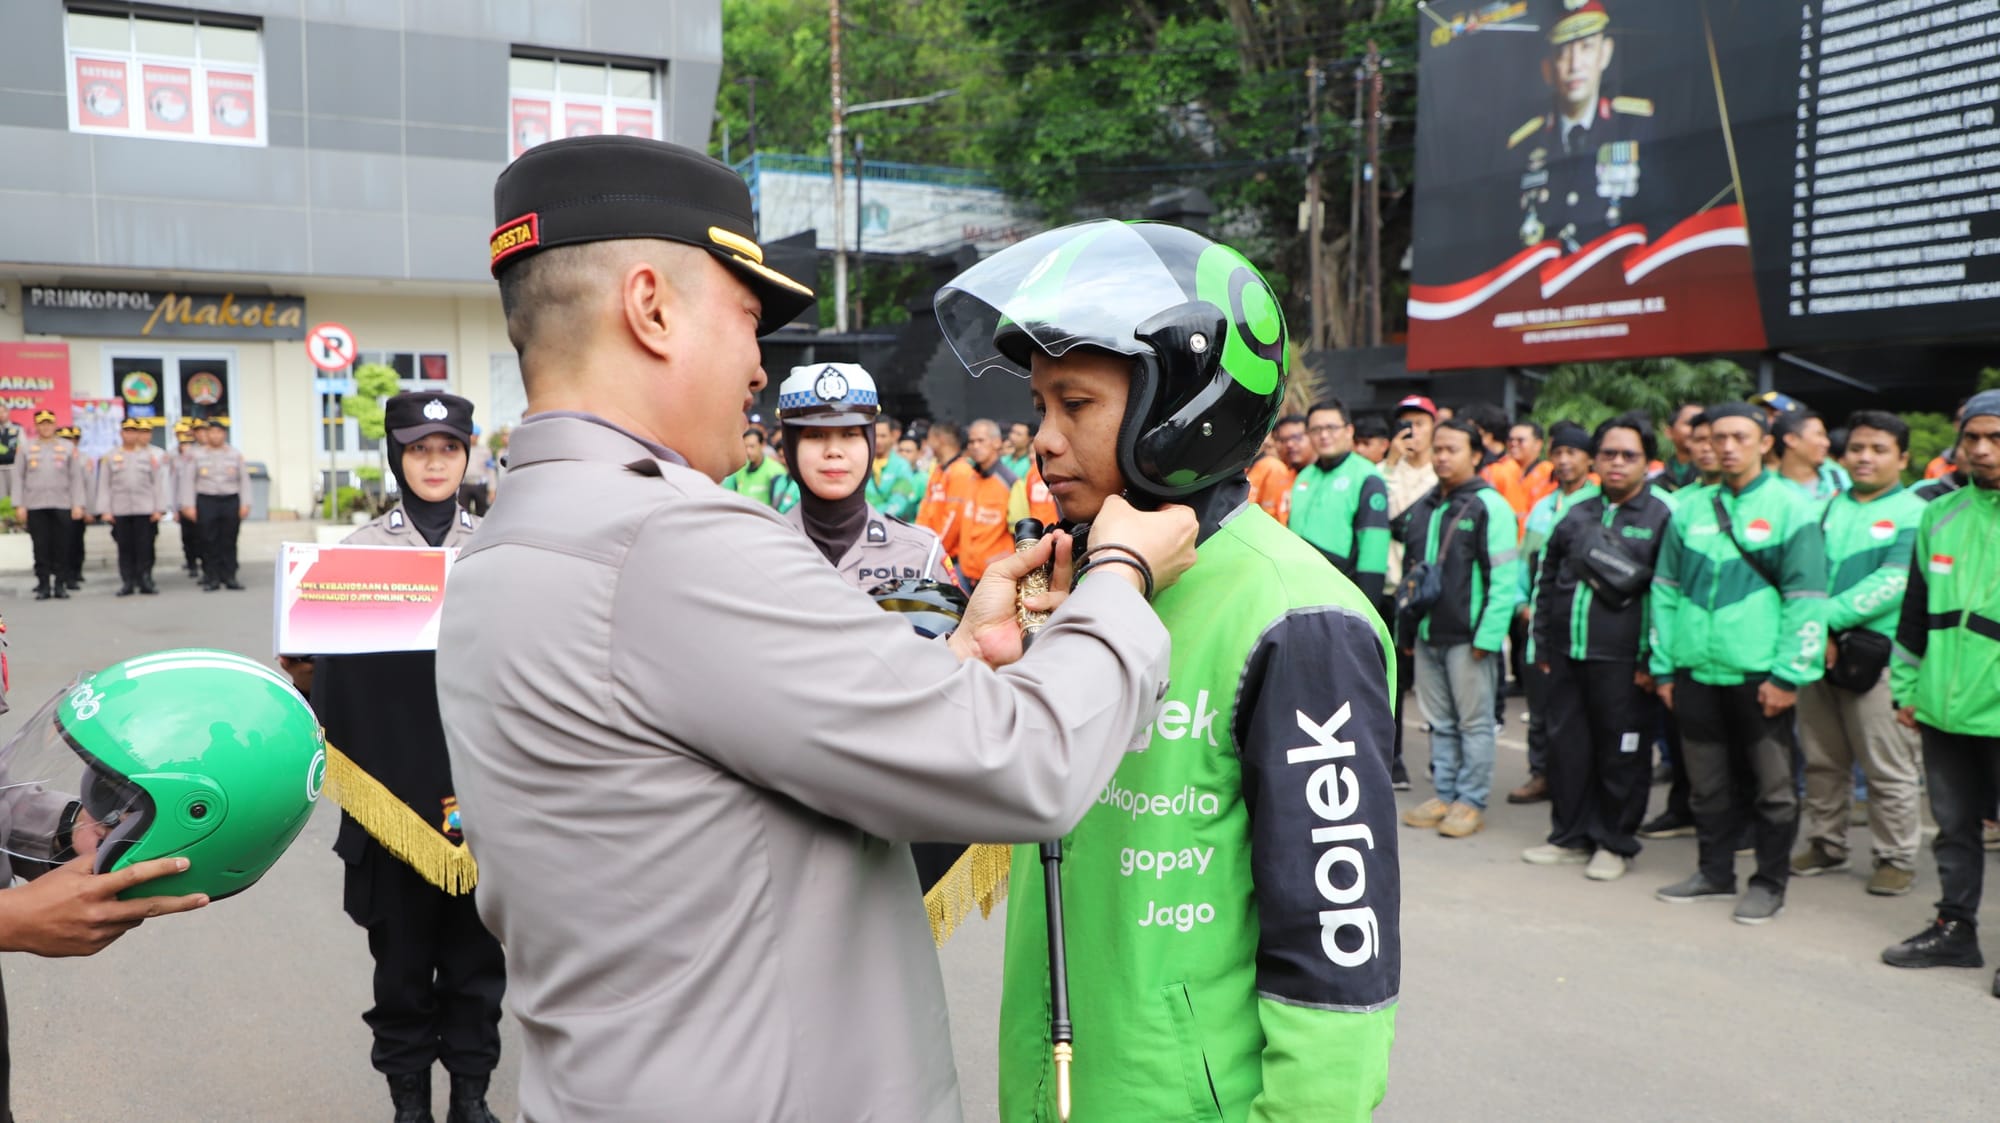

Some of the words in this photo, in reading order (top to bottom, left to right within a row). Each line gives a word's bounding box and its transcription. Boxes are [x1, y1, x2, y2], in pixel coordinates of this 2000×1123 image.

[31, 288, 154, 311] PRIMKOPPOL
[141, 292, 302, 335] Makota
[1286, 700, 1379, 968] gojek
[1120, 847, 1214, 879] gopay
[1138, 901, 1215, 932] Jago
